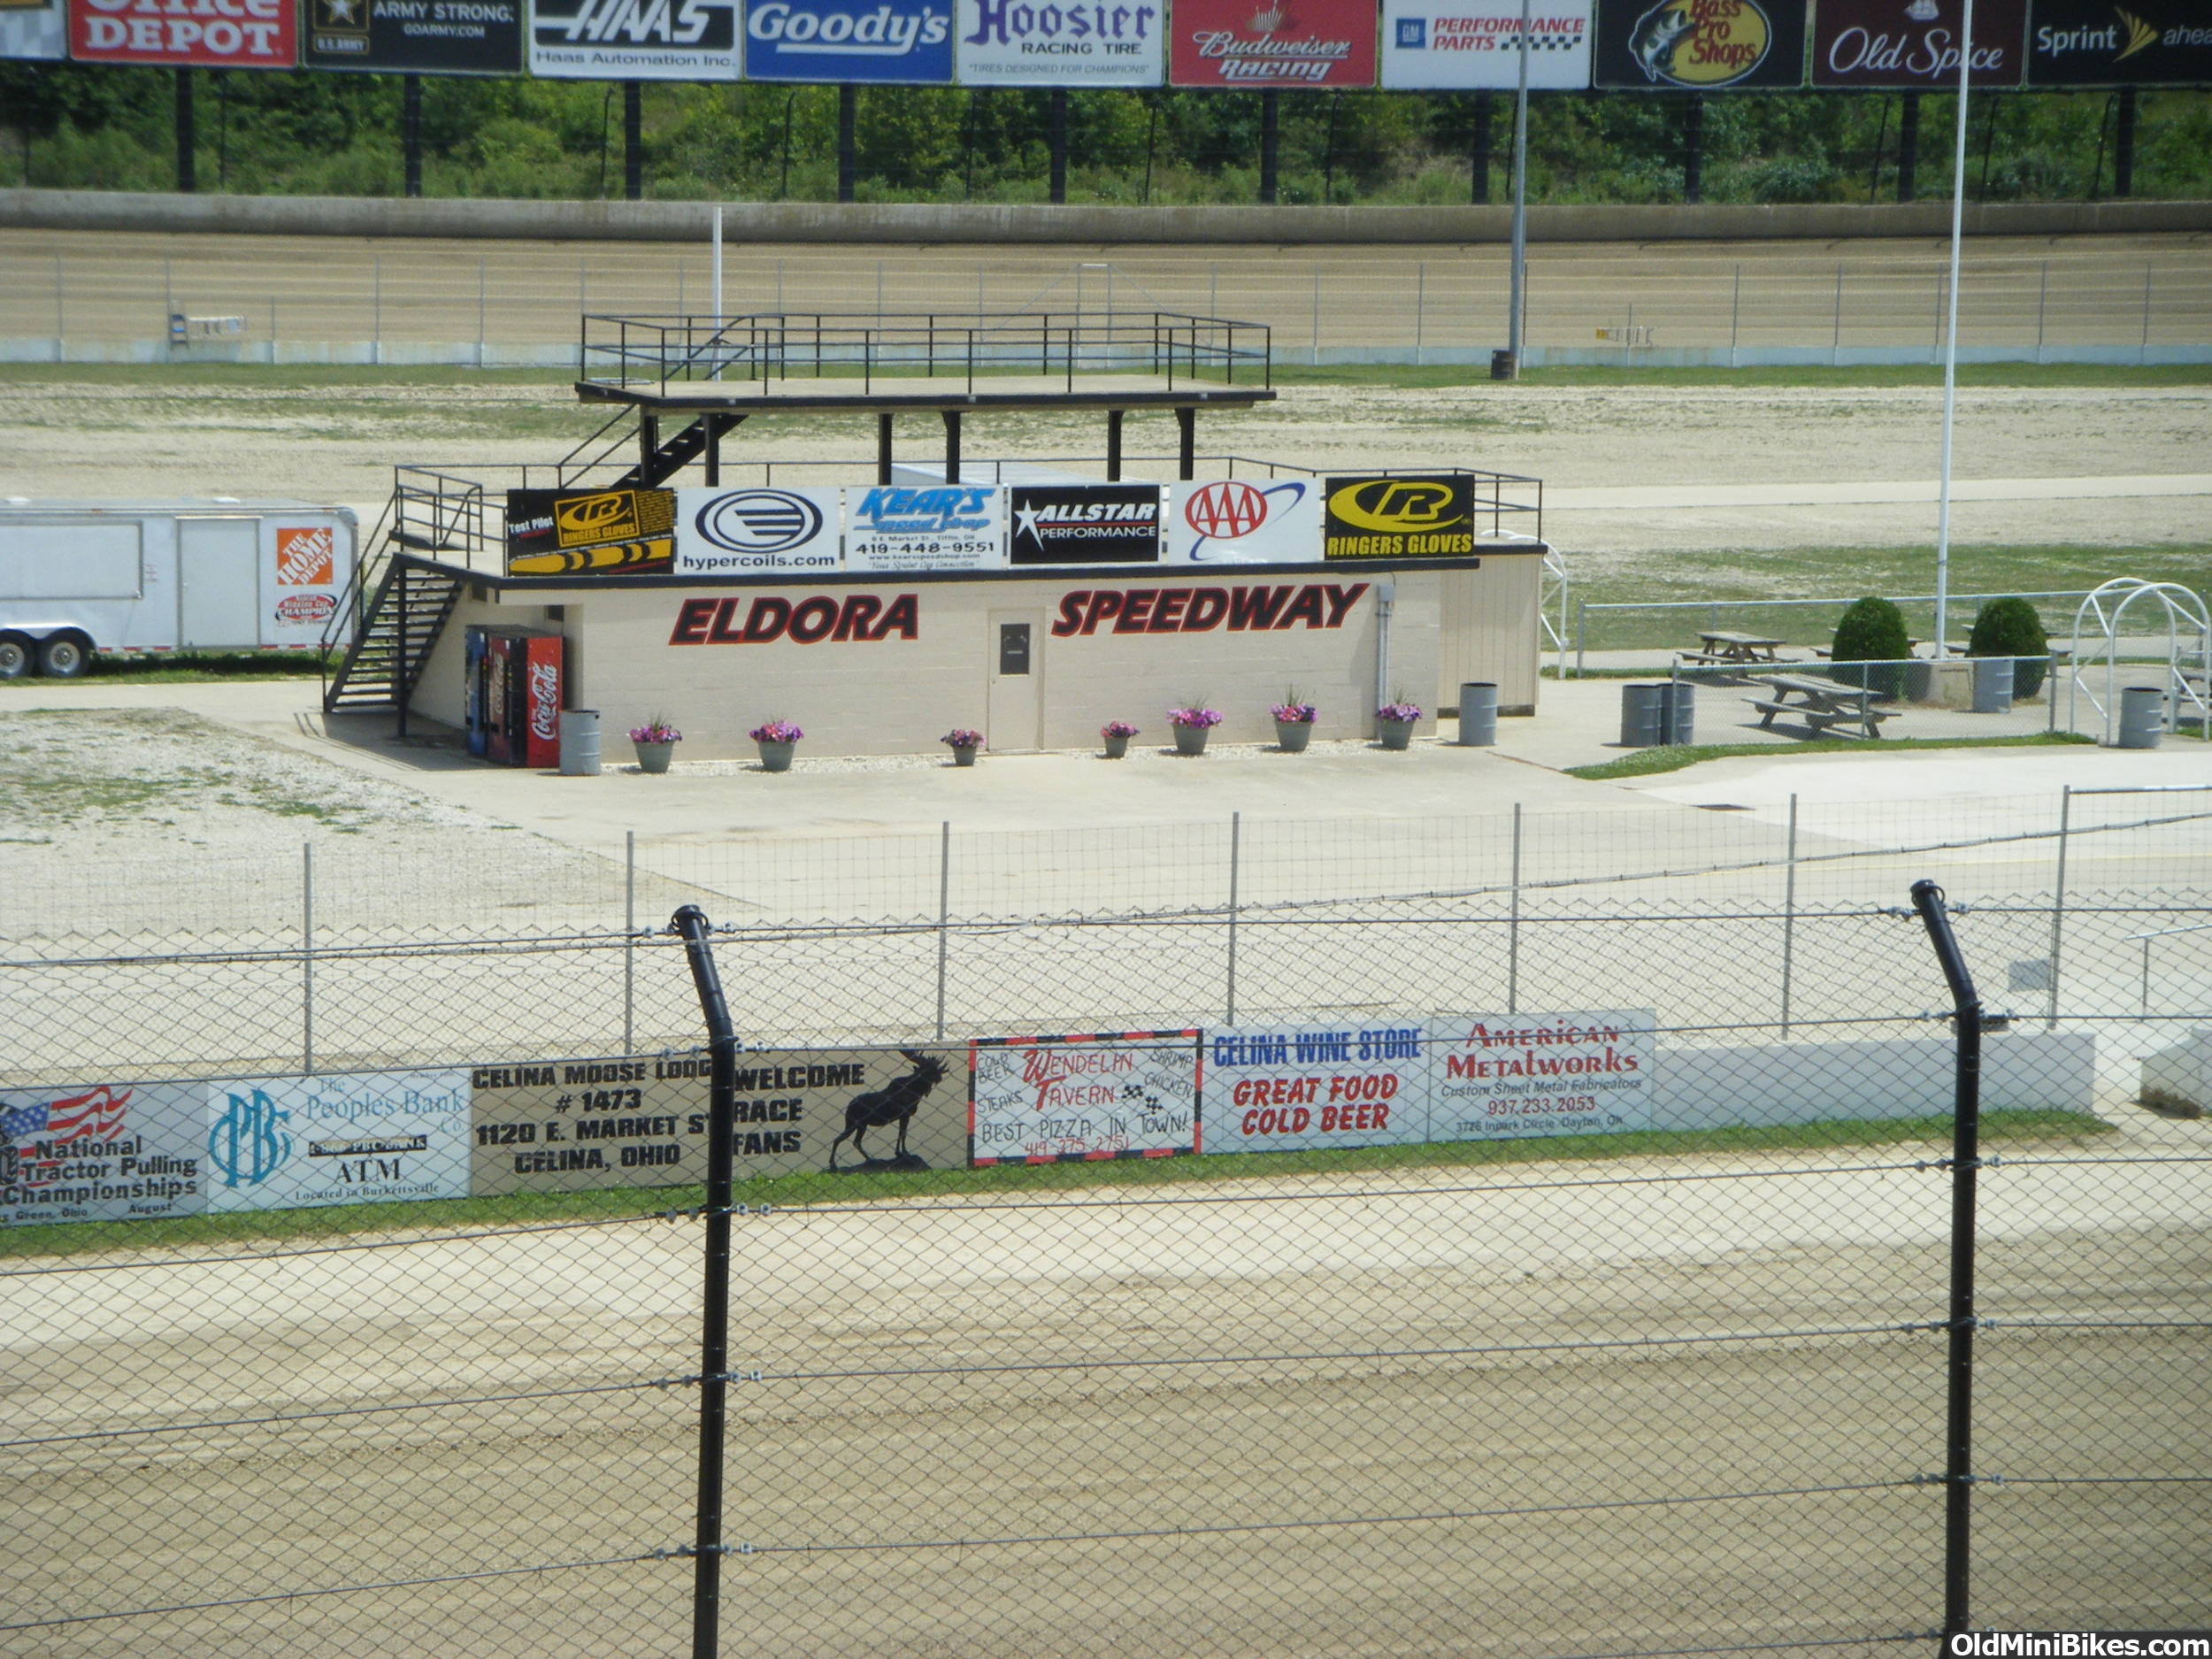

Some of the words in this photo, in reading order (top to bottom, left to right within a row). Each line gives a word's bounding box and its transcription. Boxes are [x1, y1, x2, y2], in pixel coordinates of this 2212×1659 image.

[373, 1, 428, 19] ARMY
[534, 0, 729, 42] HAAS
[1689, 0, 1741, 18] Bass
[403, 23, 485, 38] GOARMY.COM
[749, 3, 949, 56] Goody's
[964, 0, 1156, 45] Hoosier
[1402, 25, 1420, 42] GM
[1692, 18, 1732, 40] Pro
[85, 16, 280, 56] DEPOT
[1021, 42, 1093, 55] RACING
[1105, 42, 1142, 55] TIRE
[1193, 31, 1352, 58] Budweiser
[1432, 35, 1495, 50] PARTS
[2038, 25, 2117, 58] Sprint
[536, 51, 585, 65] Haas
[591, 52, 698, 66] Automation
[703, 56, 736, 67] Inc.
[1689, 39, 1756, 69] Shops
[1829, 27, 1903, 73] Old
[1906, 28, 2003, 80] Spce
[1004, 65, 1059, 74] DESIGNED
[1061, 65, 1083, 74] FOR
[1036, 503, 1156, 522] ALLSTAR
[1194, 482, 1260, 538] AAA
[509, 520, 531, 534] Test
[532, 517, 554, 530] Pilot
[564, 527, 601, 543] RINGERS
[603, 523, 635, 539] GLOVES
[1039, 526, 1156, 540] PERFORMANCE
[277, 528, 333, 585] HOME
[855, 541, 995, 555] 419-448-9551
[1327, 536, 1402, 557] RINGERS
[1408, 534, 1472, 554] GLOVES
[683, 554, 835, 570] hypercoils.com
[669, 594, 918, 645] ELDORA
[1051, 583, 1370, 637] SPEEDWAY
[1151, 1048, 1194, 1069] SHRIMP
[1213, 1034, 1288, 1067] CELINA
[1295, 1032, 1352, 1063] WINE
[1358, 1027, 1423, 1061] STORE
[319, 1078, 346, 1094] The
[472, 1066, 556, 1089] CELINA
[565, 1064, 646, 1085] MOOSE
[656, 1059, 711, 1079] LODG
[734, 1064, 865, 1091] WELCOME
[977, 1064, 1011, 1085] BEER
[1144, 1071, 1194, 1098] CHICKEN
[1034, 1075, 1116, 1111] TAVERN
[1233, 1077, 1322, 1107] GREAT
[1328, 1072, 1399, 1102] FOOD
[1440, 1085, 1490, 1097] Custom
[1494, 1082, 1530, 1094] Sheet
[1533, 1080, 1567, 1093] Metal
[1571, 1078, 1642, 1091] Fabricators
[307, 1092, 395, 1123] Peoples
[403, 1088, 463, 1114] Bank
[556, 1094, 572, 1113] #
[581, 1088, 641, 1112] 1473
[734, 1098, 803, 1123] RACE
[977, 1090, 1024, 1114] STEAKS
[1487, 1096, 1595, 1117] 937.233.2053
[476, 1123, 536, 1145] 1120
[546, 1122, 566, 1141] E.
[576, 1116, 680, 1141] MARKET
[687, 1113, 710, 1134] S
[982, 1122, 1025, 1143] BEST
[1040, 1118, 1093, 1140] PIZZA
[1110, 1117, 1127, 1134] IN
[1140, 1111, 1187, 1134] TOWN!
[1241, 1107, 1310, 1136] COLD
[1320, 1102, 1390, 1133] BEER
[35, 1135, 142, 1159] National
[733, 1130, 802, 1156] FANS
[20, 1161, 111, 1181] Tractor
[121, 1156, 197, 1177] Pulling
[514, 1148, 611, 1173] CELINA,
[621, 1144, 681, 1167] OHIO
[336, 1159, 401, 1184] ATM
[3, 1178, 197, 1205] Championships
[296, 1188, 343, 1201] Located
[346, 1188, 357, 1197] in
[62, 1207, 88, 1217] Ohio
[128, 1202, 172, 1214] August
